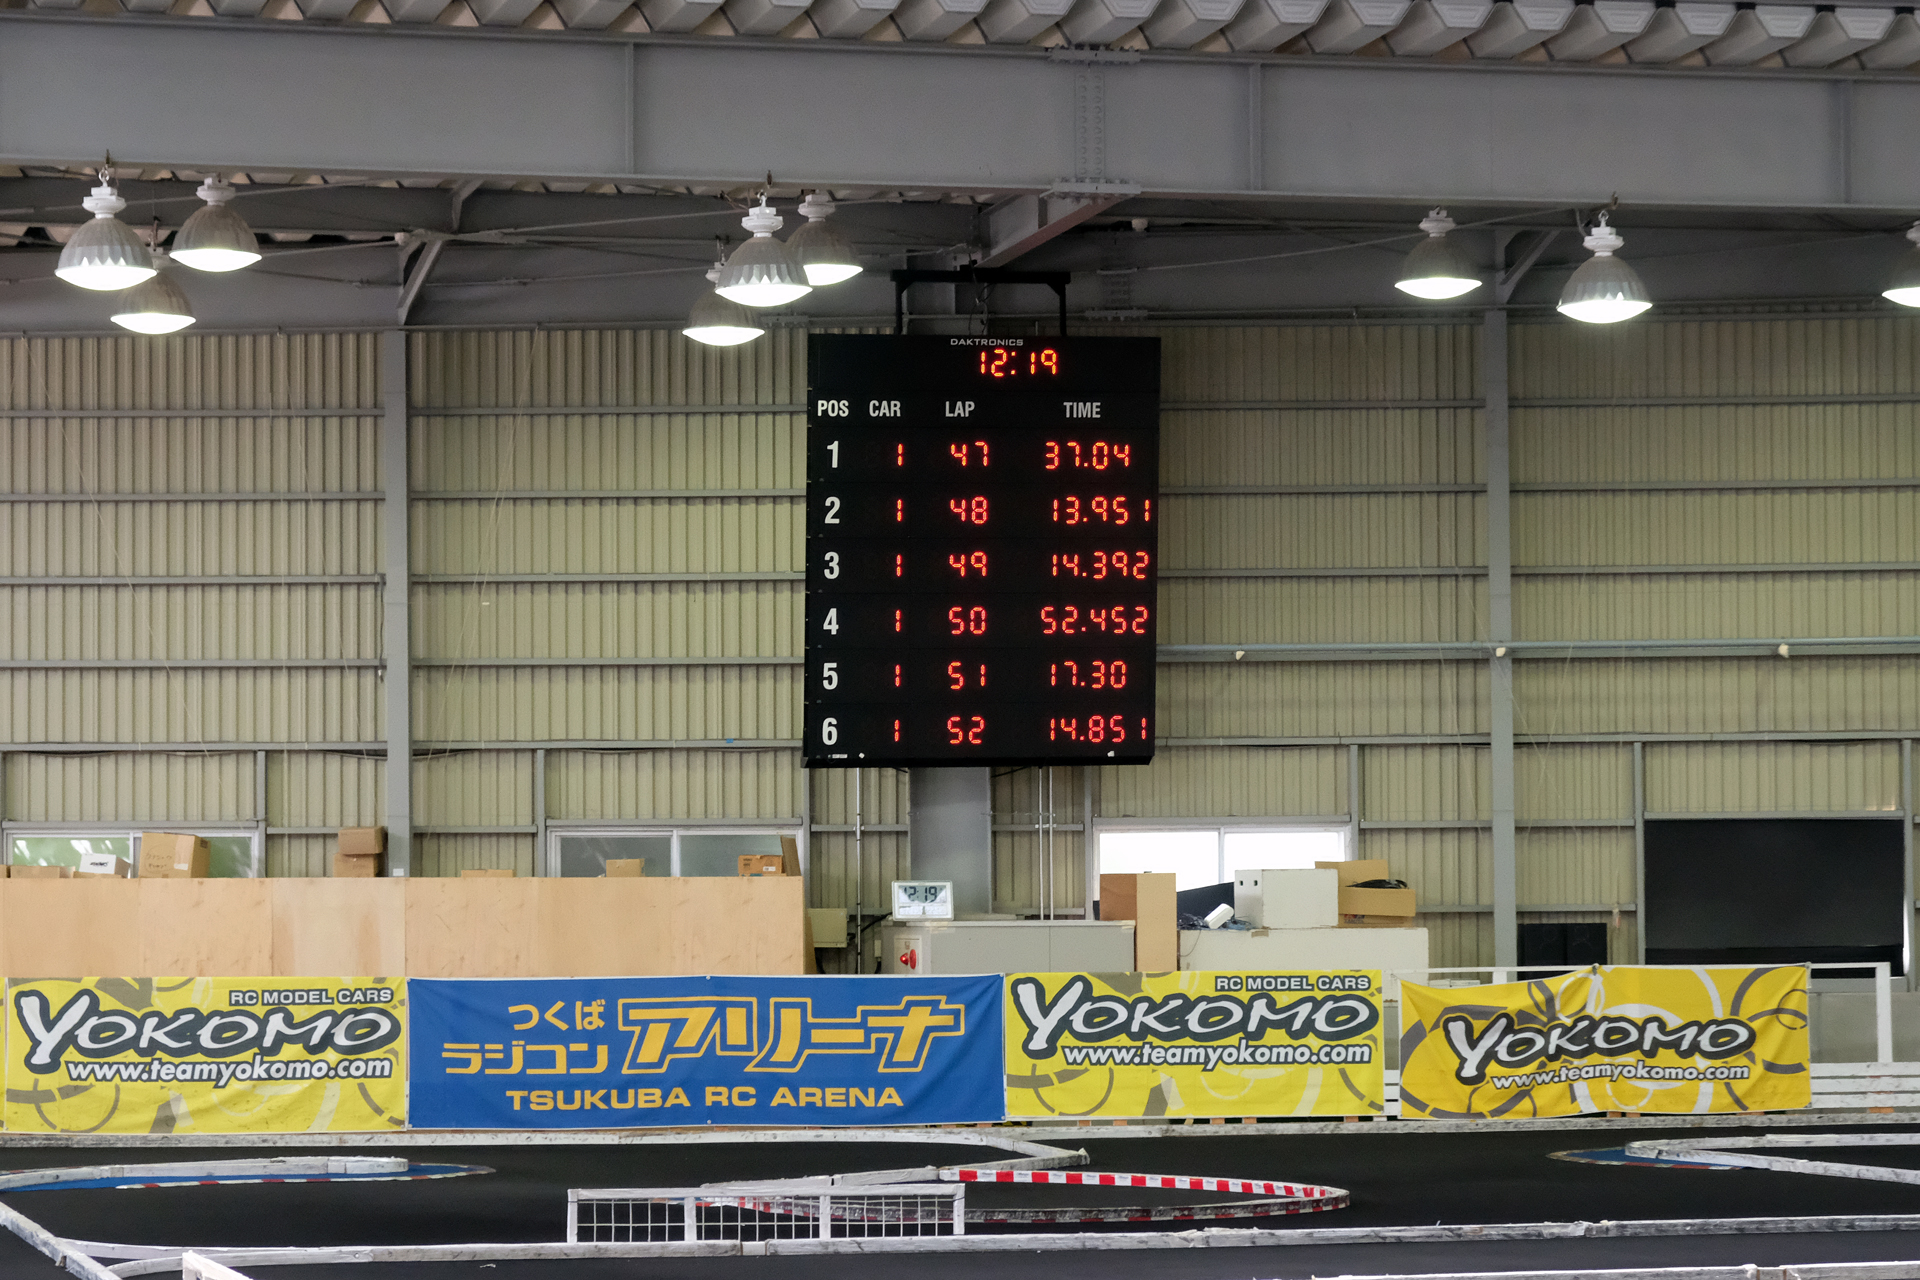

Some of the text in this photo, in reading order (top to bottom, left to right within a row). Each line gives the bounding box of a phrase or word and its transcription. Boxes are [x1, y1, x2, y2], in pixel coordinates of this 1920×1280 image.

[950, 338, 1024, 346] DAKTRONICS
[980, 348, 1058, 377] 12:19
[817, 400, 1102, 418] POS CAR LAP TIME
[827, 441, 1131, 470] 1 1 47 37.04
[825, 496, 1151, 525] 2 1 48 13.951
[824, 551, 1149, 579] 3 1 49 14.392
[823, 606, 1149, 635] 4 1 50 52.452
[823, 661, 1127, 690] 5 1 51 17.30
[823, 715, 1147, 745] 6 1 52 14.851
[230, 988, 393, 1004] RC MODEL CARS
[1215, 976, 1370, 990] RC MODEL CARS
[18, 993, 394, 1066] YOKOMO
[508, 999, 606, 1031] つくば
[1015, 980, 1371, 1051] YOKOMO
[617, 995, 966, 1075] アリーナ
[1446, 1016, 1751, 1078] YOKOMO
[441, 1041, 609, 1075] ラジコン
[1063, 1038, 1371, 1071] www.teamyokomo.com
[66, 1055, 392, 1087] www.teamyokomo.com
[1491, 1060, 1750, 1089] www.teamyokomo.com
[506, 1086, 904, 1111] TSUKUBA RC ARENA
